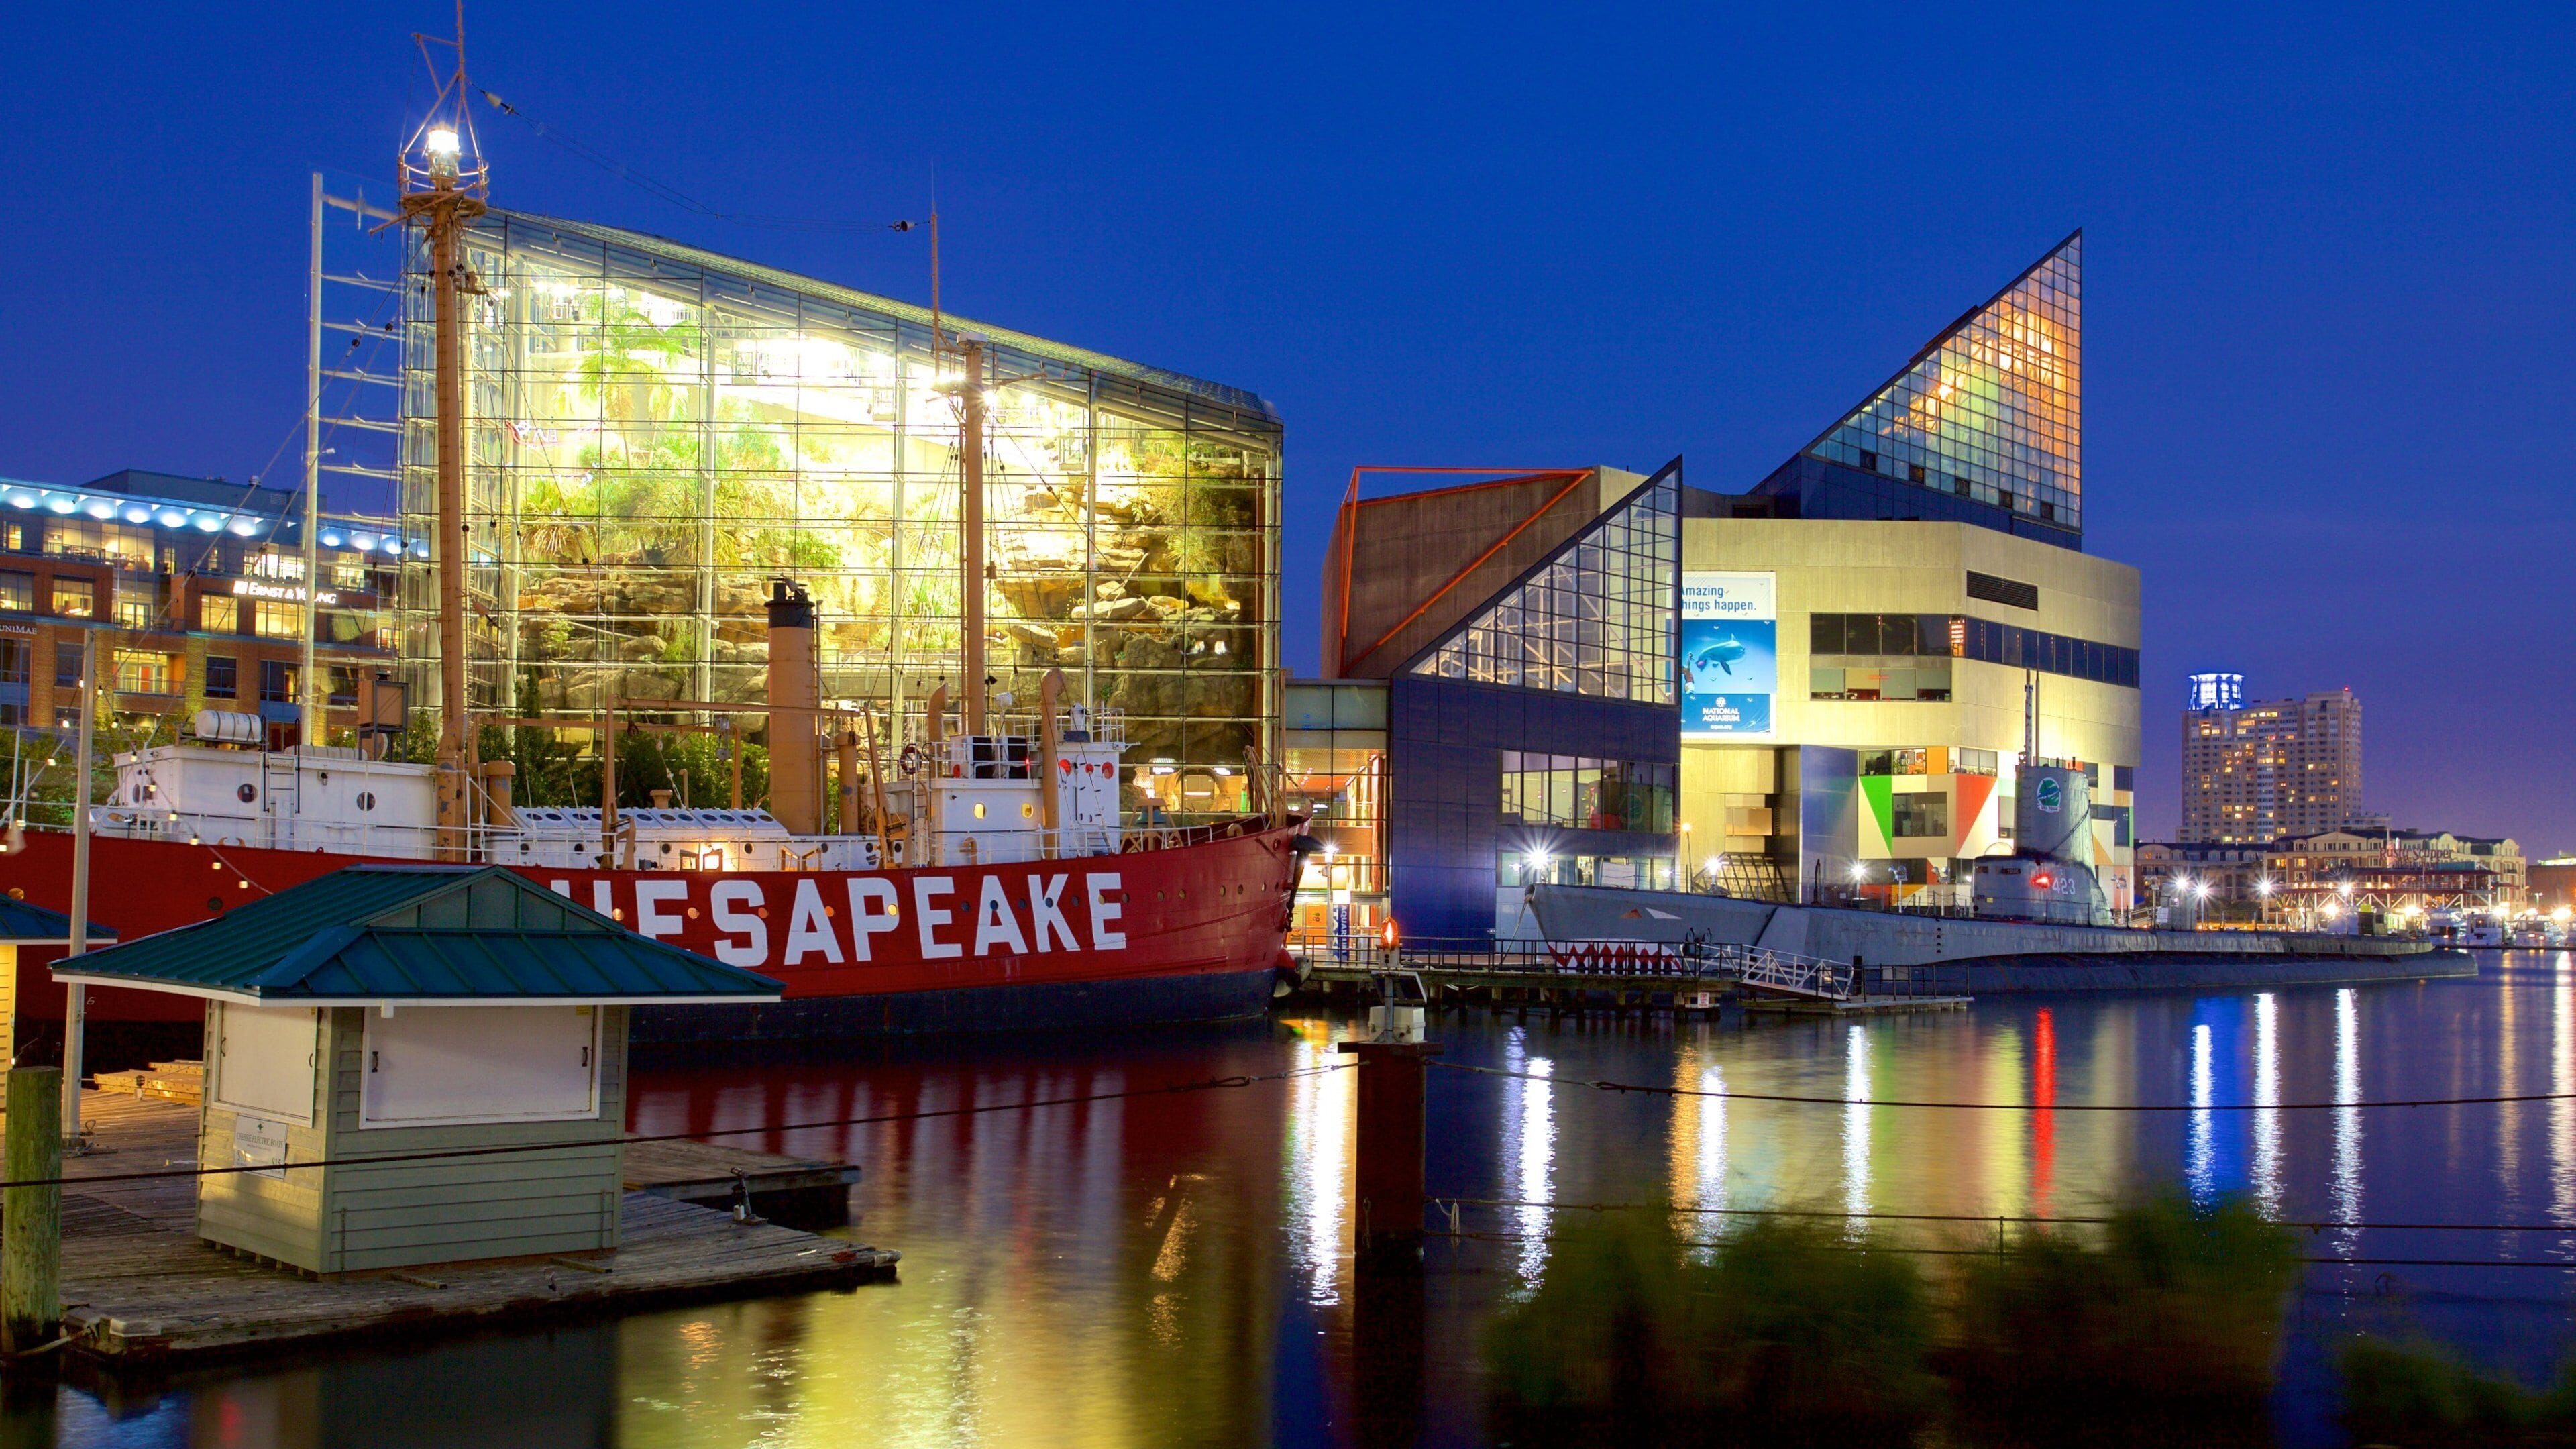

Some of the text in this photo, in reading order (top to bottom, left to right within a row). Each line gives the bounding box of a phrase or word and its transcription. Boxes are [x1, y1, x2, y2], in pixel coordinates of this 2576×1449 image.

[248, 582, 337, 604] ERNST & YNG
[1714, 599, 1756, 612] happen.
[1702, 707, 1740, 715] NATIONAL
[2052, 877, 2076, 895] 423
